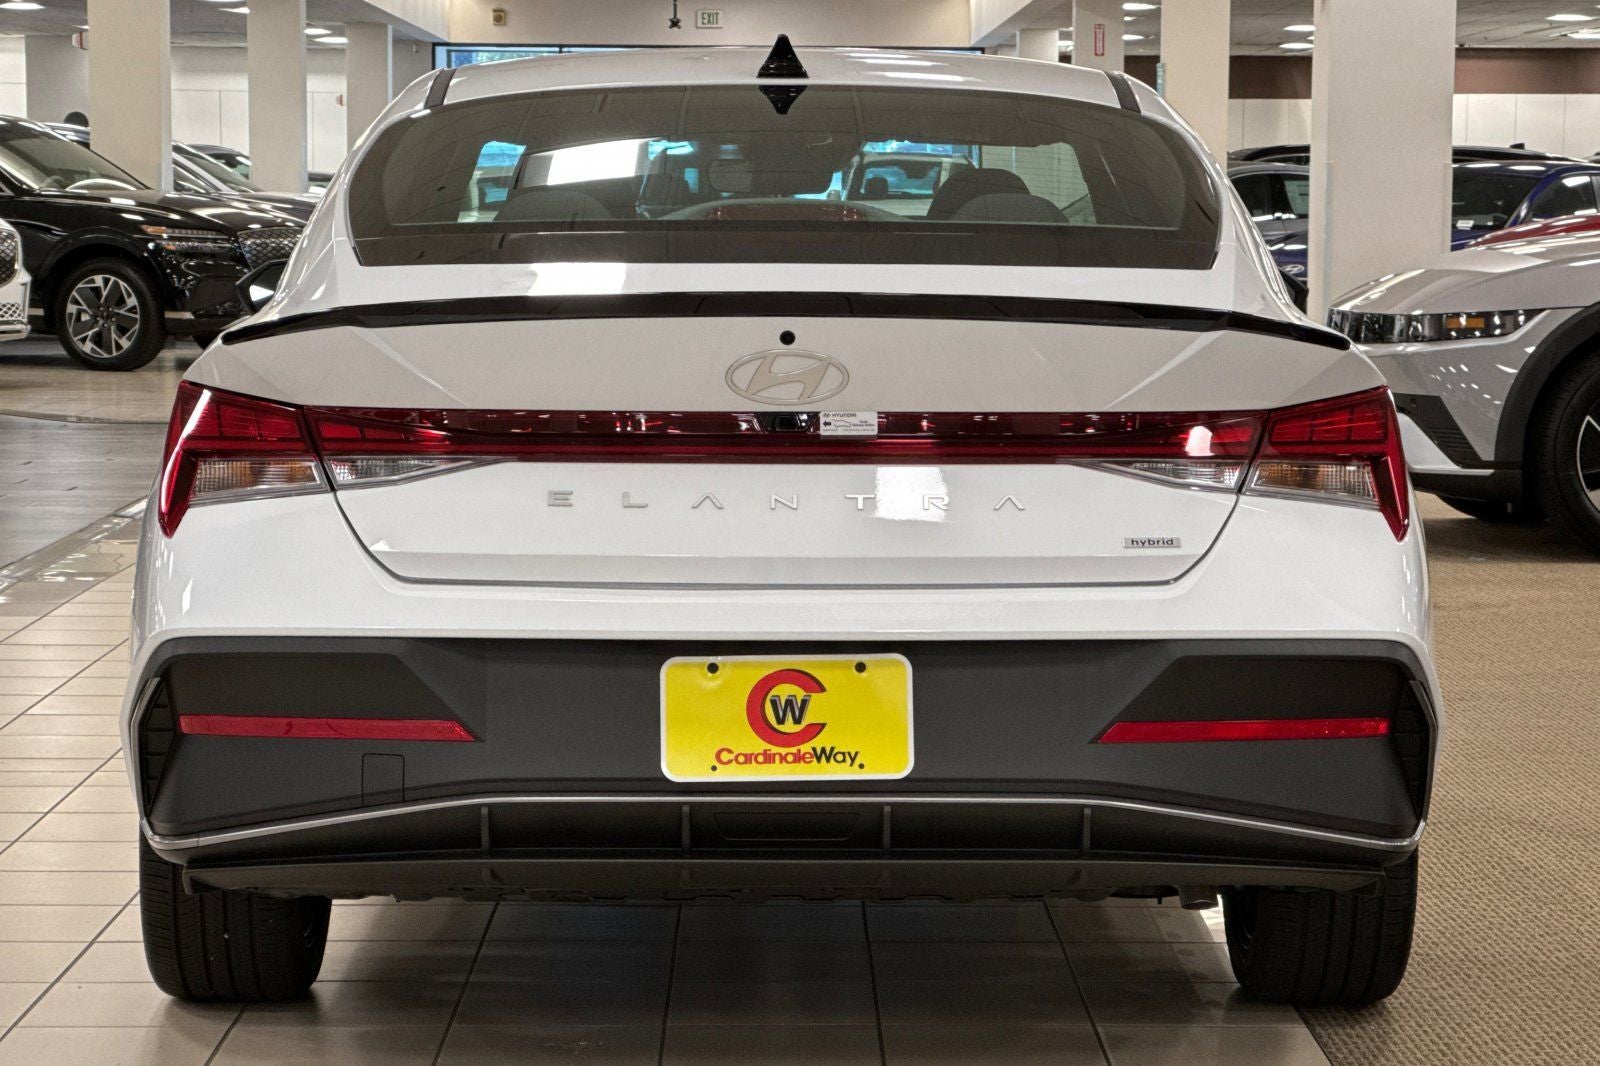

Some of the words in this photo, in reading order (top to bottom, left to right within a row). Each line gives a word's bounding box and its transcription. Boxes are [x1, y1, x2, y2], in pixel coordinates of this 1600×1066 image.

[701, 12, 720, 25] EXIT
[547, 490, 1026, 511] ELANTRA
[1131, 538, 1174, 546] hybrid
